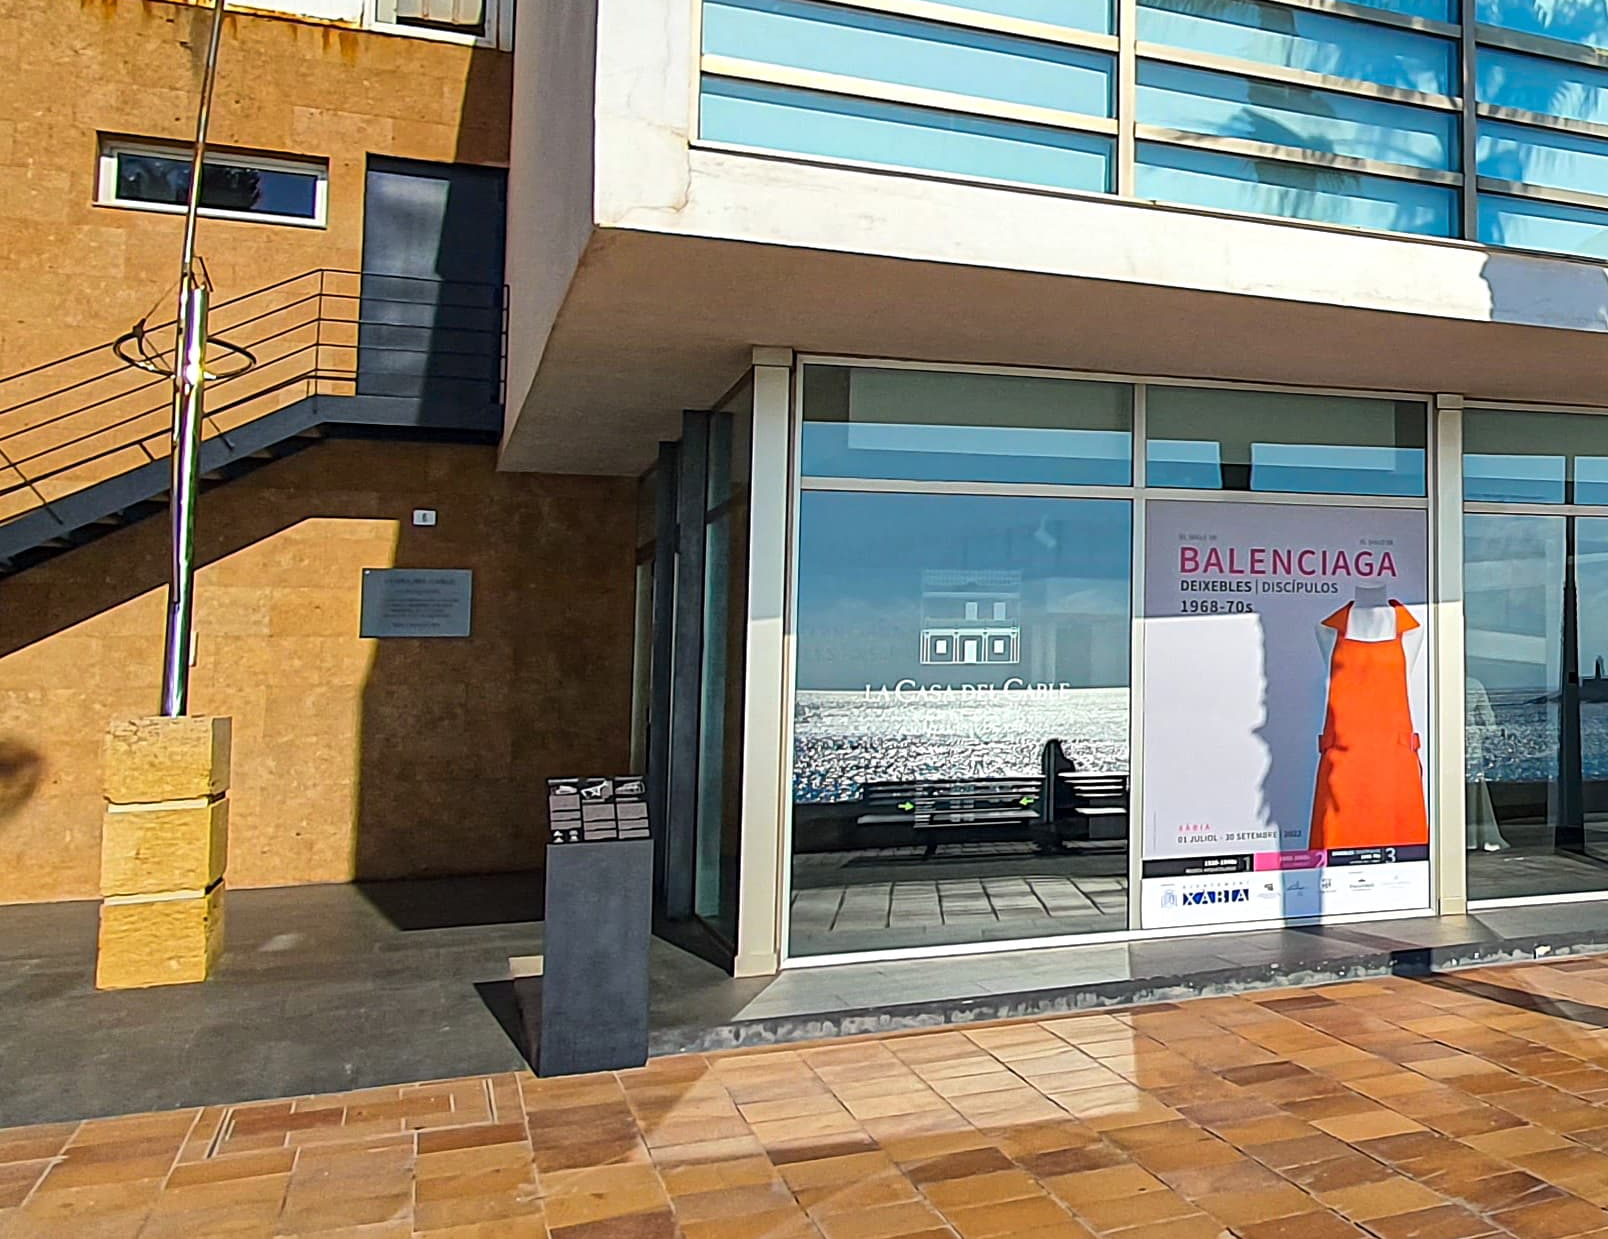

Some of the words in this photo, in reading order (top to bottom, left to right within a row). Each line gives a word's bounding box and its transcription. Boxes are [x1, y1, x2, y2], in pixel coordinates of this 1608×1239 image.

[1180, 546, 1397, 578] BALENCIAGA
[1180, 580, 1252, 593] DEIXEBLES
[1262, 580, 1338, 594] DISCÍPULOS
[1181, 599, 1253, 614] 1968-70s
[1385, 847, 1396, 863] 3
